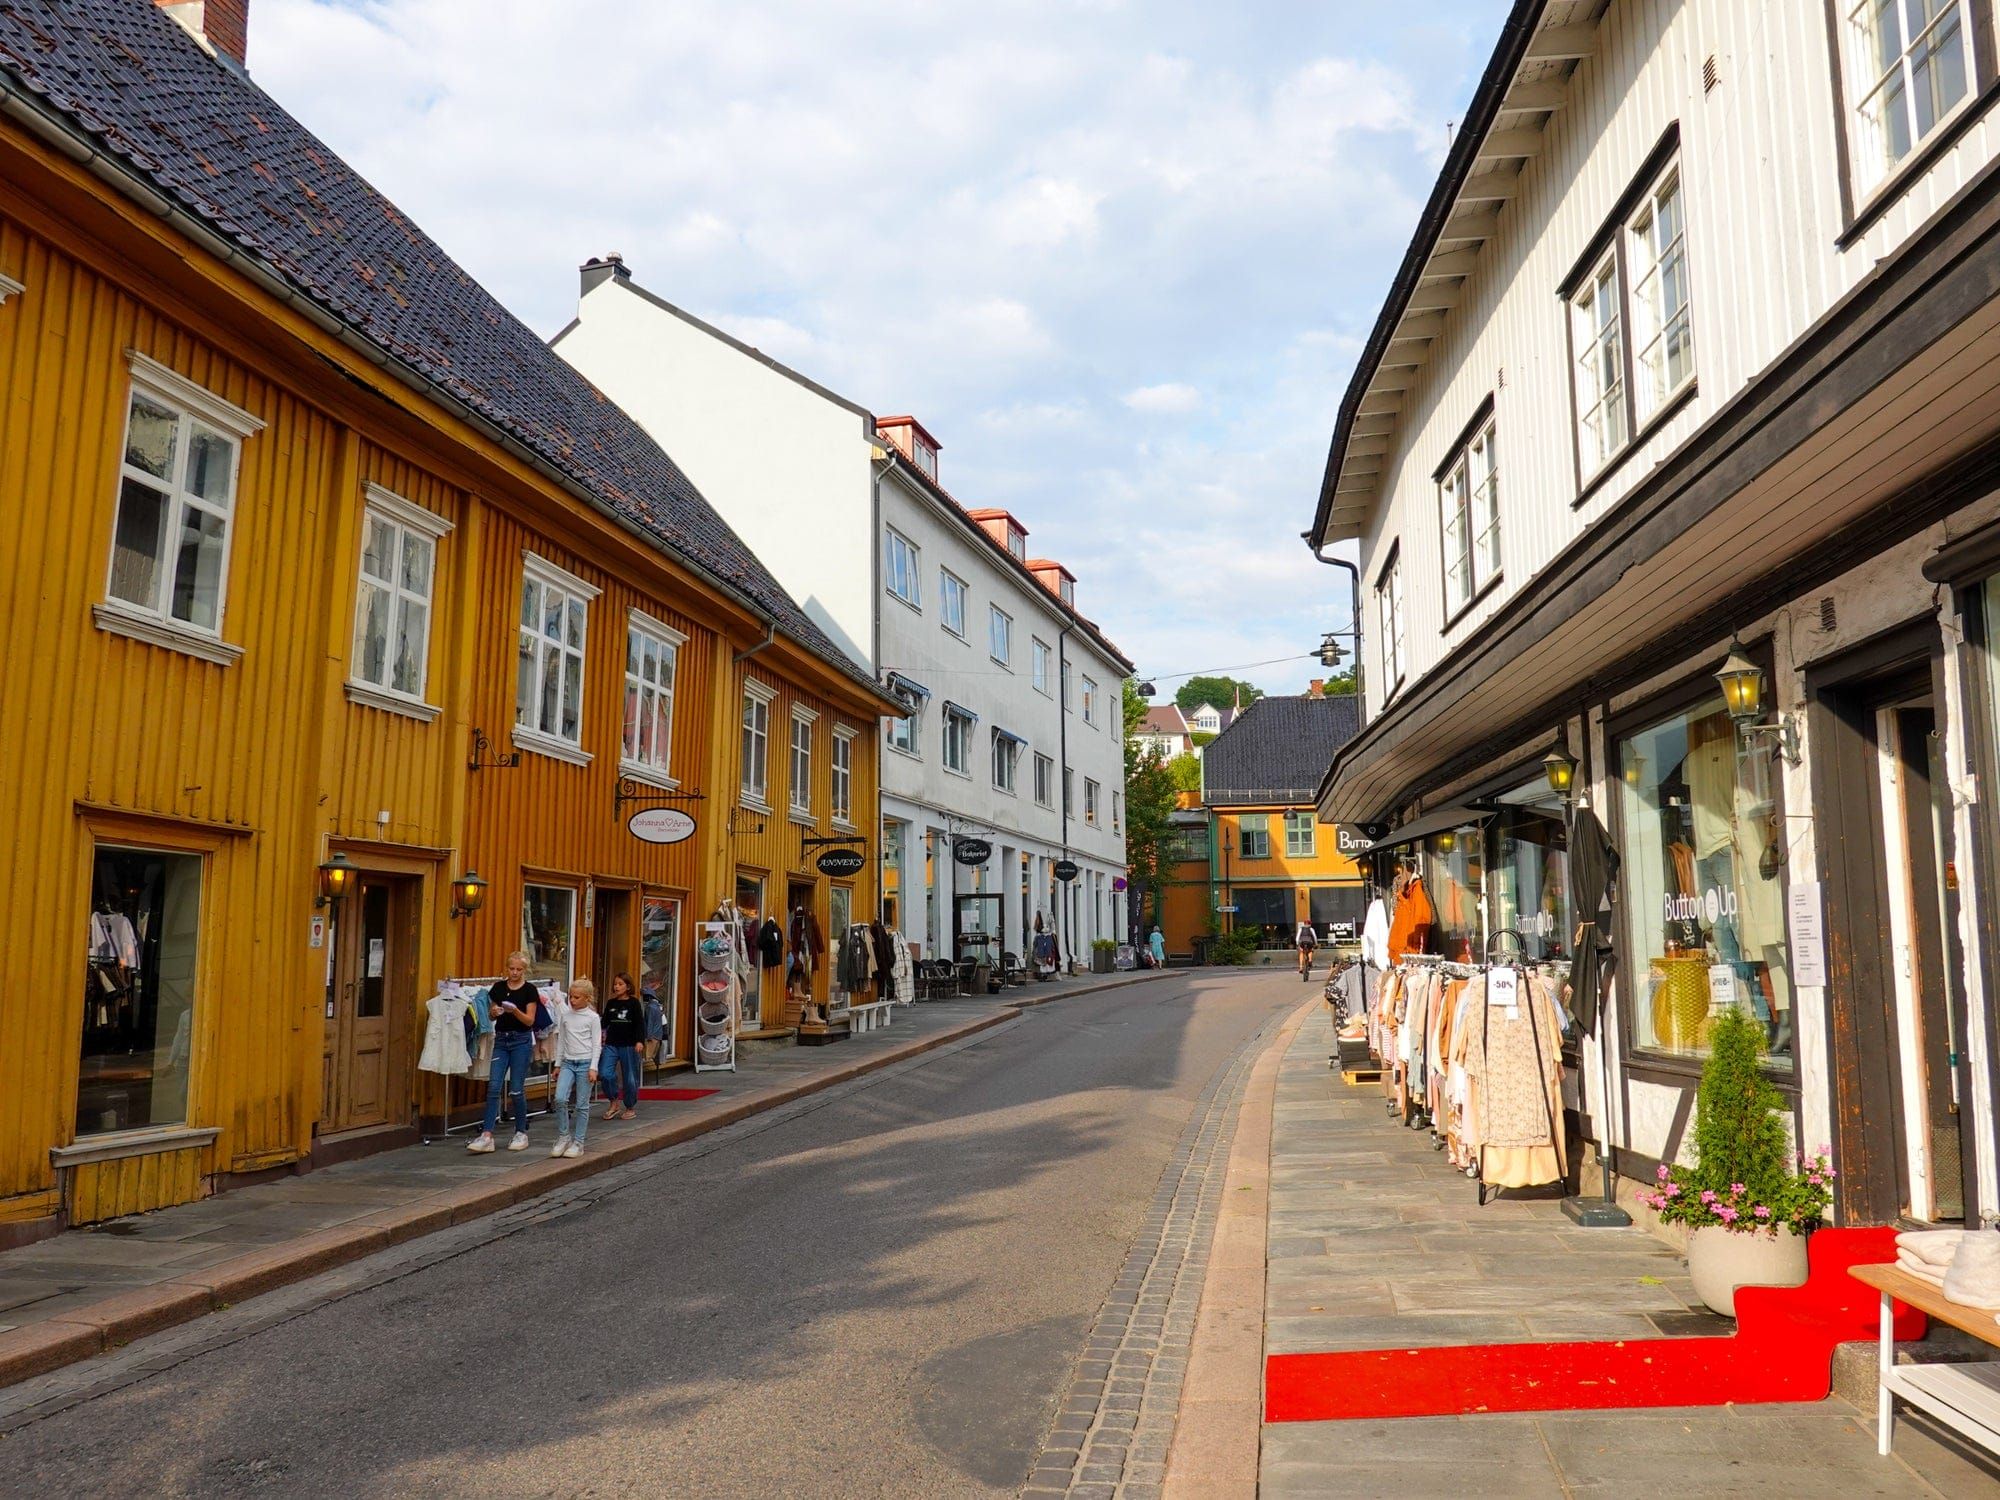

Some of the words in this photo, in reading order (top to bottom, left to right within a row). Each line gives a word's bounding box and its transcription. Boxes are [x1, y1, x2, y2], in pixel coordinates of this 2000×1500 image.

[1664, 892, 1705, 921] Button
[1718, 884, 1737, 924] Up
[1329, 922, 1353, 931] HOPE
[1493, 980, 1513, 989] -50%
